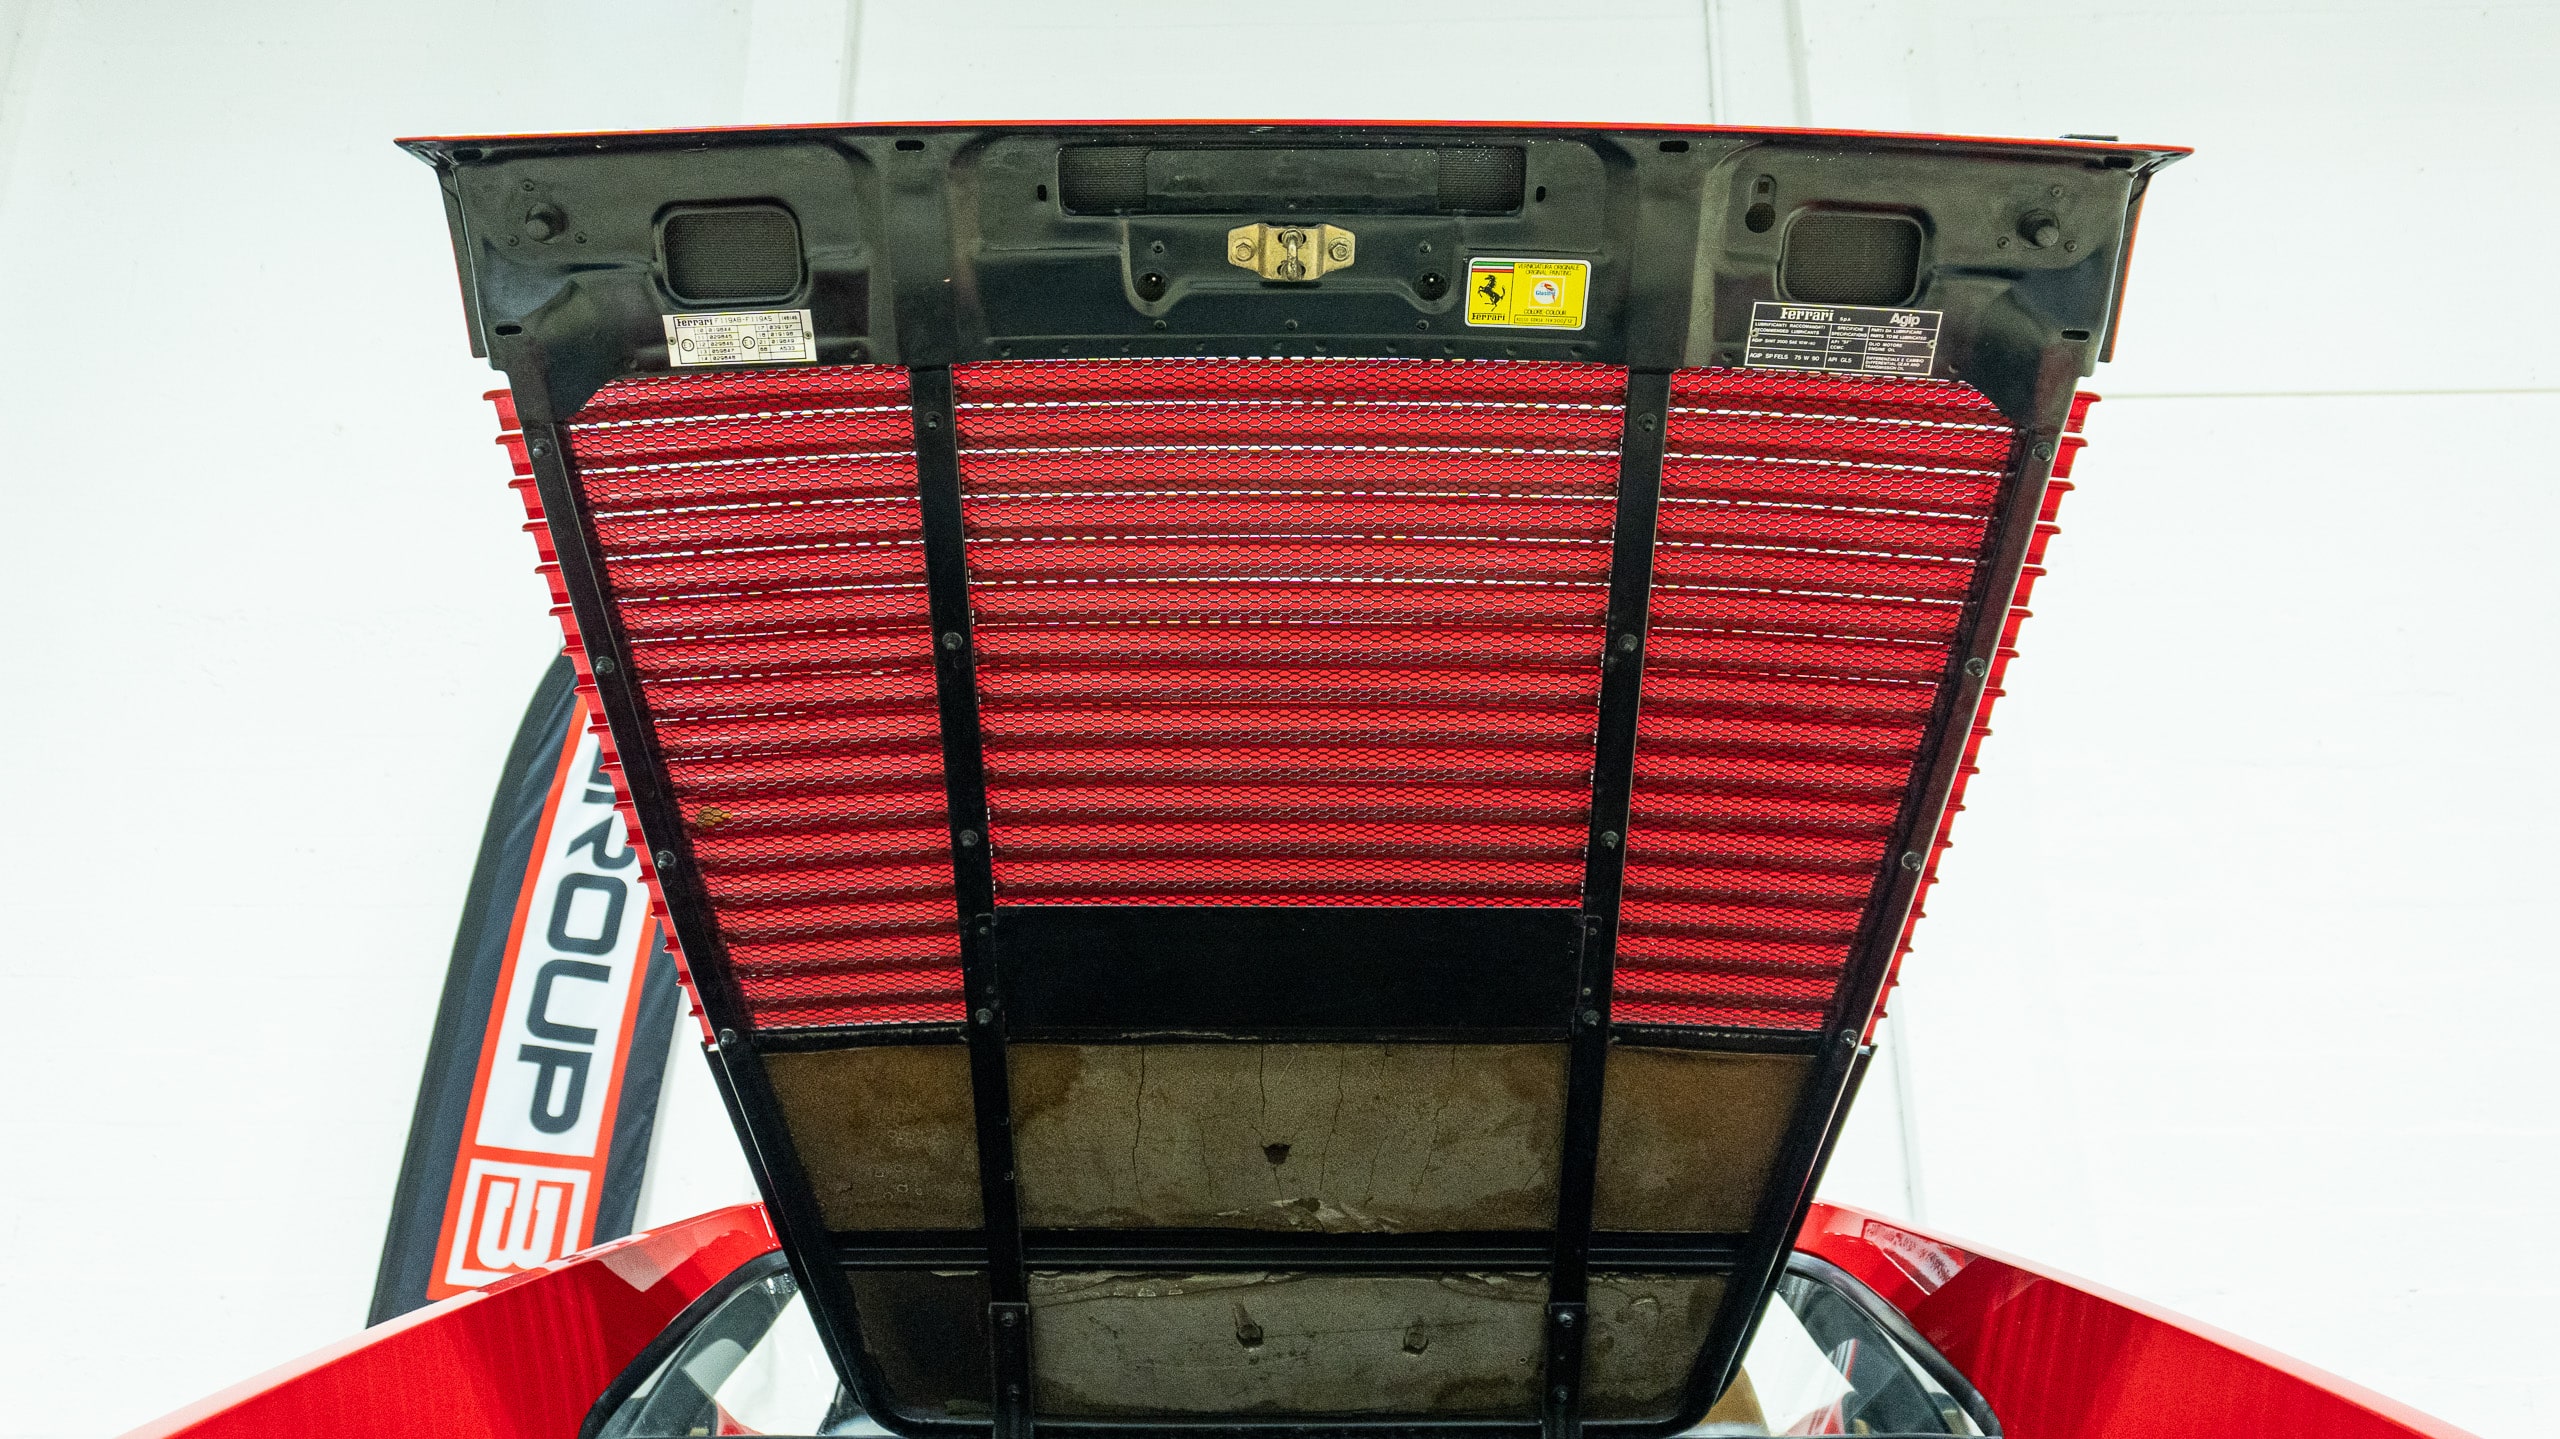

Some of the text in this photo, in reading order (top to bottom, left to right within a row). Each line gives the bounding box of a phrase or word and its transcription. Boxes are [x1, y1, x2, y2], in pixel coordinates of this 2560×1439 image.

[1472, 312, 1505, 321] Ferrari
[1780, 307, 1834, 321] Ferrari
[1890, 312, 1920, 327] Agip
[677, 318, 712, 326] Ferrari
[519, 743, 636, 1135] ROUP
